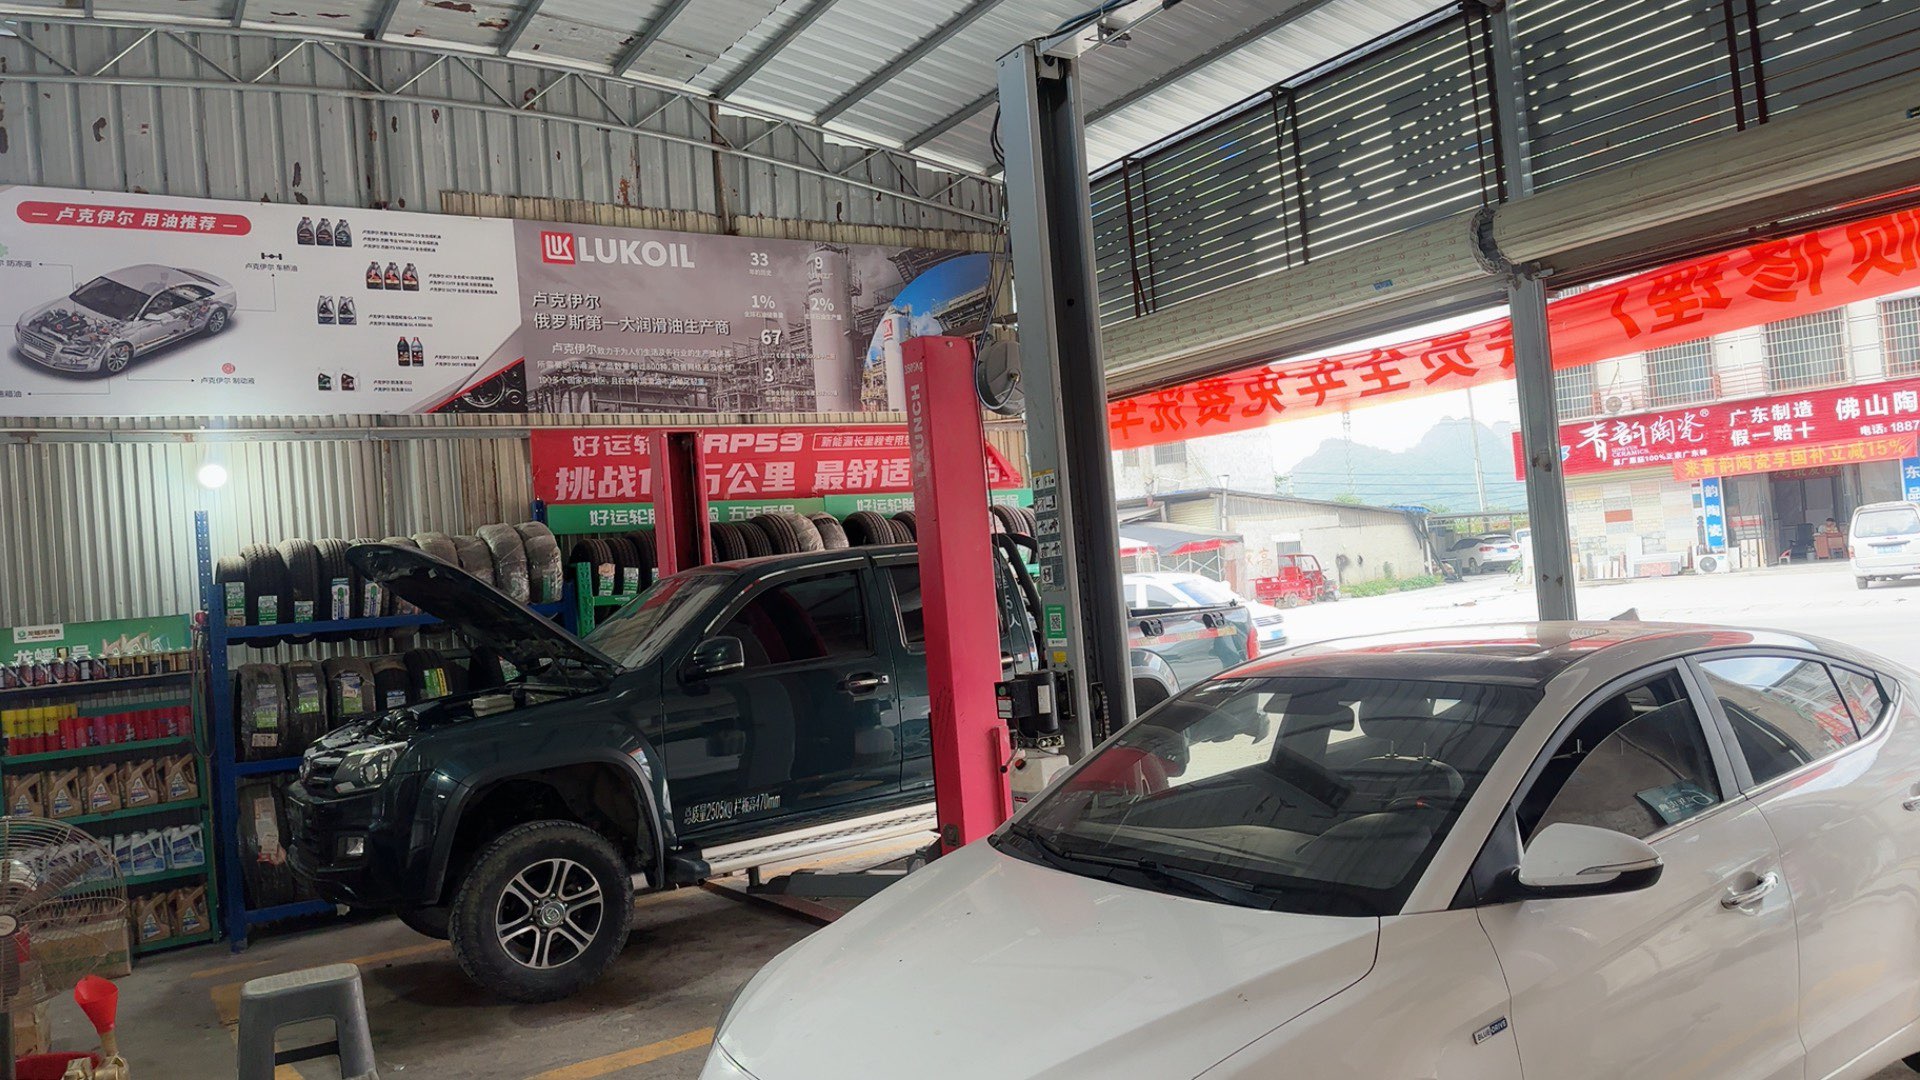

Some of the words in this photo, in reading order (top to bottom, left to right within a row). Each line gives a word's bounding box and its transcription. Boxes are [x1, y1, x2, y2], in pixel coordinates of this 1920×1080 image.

[56, 206, 135, 225] 卢克伊尔
[141, 211, 216, 231] 用油推荐
[578, 236, 695, 269] LUKOIL
[750, 252, 769, 266] 33
[814, 256, 823, 269] 9
[533, 291, 601, 310] 卢克伊尔
[751, 295, 776, 309] 1%
[809, 298, 835, 311] 2%
[533, 312, 731, 336] 俄罗斯第一大润滑油生产商
[761, 329, 781, 345] 67
[764, 367, 775, 382] 3
[1835, 390, 1918, 421] 佛山陶
[910, 384, 928, 478] LAUNCH
[1576, 412, 1705, 463] 青韵陶瓷
[1729, 400, 1814, 427] 广东制造
[1731, 421, 1815, 447] 假一赔十
[1684, 440, 1907, 478] 来青韵陶瓷享国补立减15%
